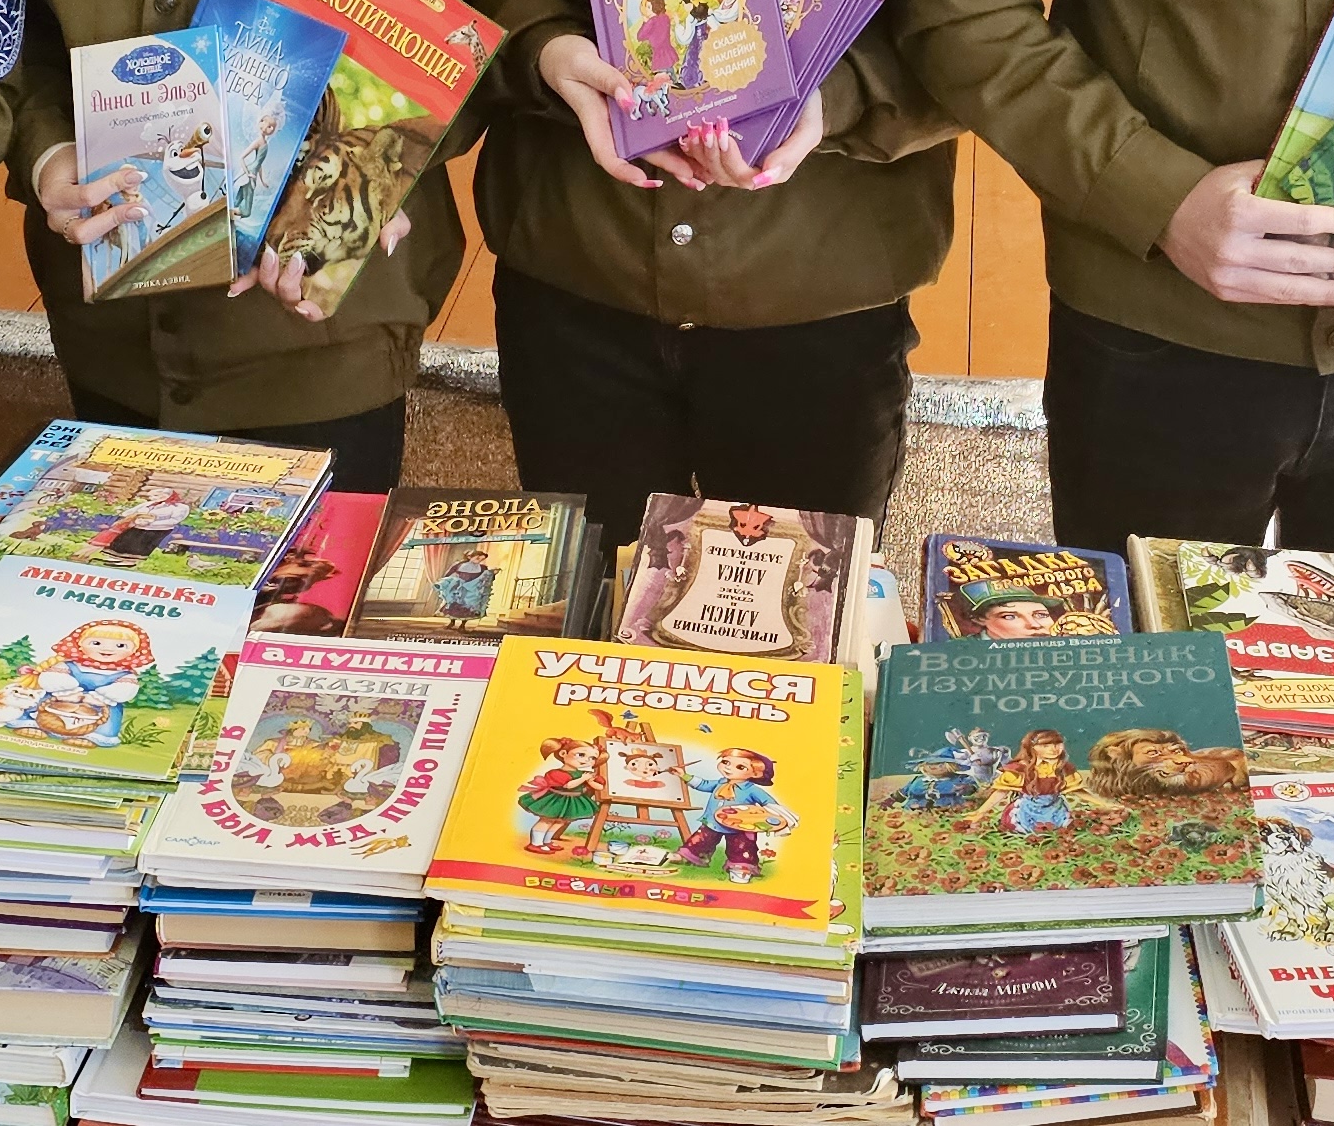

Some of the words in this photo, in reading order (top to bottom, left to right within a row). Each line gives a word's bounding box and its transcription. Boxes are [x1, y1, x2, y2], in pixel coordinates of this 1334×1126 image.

[233, 19, 285, 65] ТАЙНА
[712, 31, 747, 50] СКАЗКИ
[126, 52, 172, 69] ХОЛОДНОЕ
[708, 42, 756, 66] НАКЛЕЙКИ
[135, 63, 164, 76] СЕРДЦЕ
[713, 56, 756, 79] ЗАДАНИЯ
[90, 89, 135, 114] Анна
[140, 88, 154, 105] и
[157, 80, 209, 104] Эльза
[109, 108, 170, 130] Королевство
[170, 106, 195, 119] лета
[132, 278, 161, 290] ЭРИКА
[162, 274, 191, 287] ДЭВИД
[107, 447, 265, 475] ВНУЧКИ-БАБУШКИ
[426, 498, 542, 517] ЭНОЛА
[420, 515, 544, 534] ХОЛМС
[705, 545, 784, 565] ЗАЗЕРКАЛЬЕ
[943, 550, 1089, 584] ЗАГАДКА
[18, 564, 218, 607] Машенька
[717, 563, 767, 585] АЛИСА
[991, 567, 1096, 591] БРОНЗОВОГО
[1046, 575, 1104, 597] ЛЬВА
[64, 589, 184, 620] медведь
[699, 604, 759, 627] АЛИСЫ
[672, 619, 778, 644] ПРИКЛЮЧЕНИЯ
[988, 638, 1065, 650] Александр
[1068, 636, 1122, 647] Волков
[300, 651, 465, 675] ПУШКИН
[918, 644, 1196, 673] ВОЛШЕБНИК
[277, 673, 433, 698] СКАЗКИ
[534, 650, 817, 704] УЧИМСЯ
[900, 665, 1216, 695] ИЗУМРУДНОГО
[1254, 683, 1292, 692] САДА
[554, 682, 790, 723] рисовать
[972, 690, 1145, 715] ГОРОДА
[7, 735, 55, 750] народная
[219, 725, 247, 742] Я
[379, 757, 440, 824] ПИВО
[200, 802, 274, 850] БЫЛ,
[284, 823, 389, 850] МЁД,
[164, 835, 222, 848] САМОВАР
[524, 875, 637, 897] ВЕСЁЛЫЙ
[995, 977, 1058, 996] МЕРФИ
